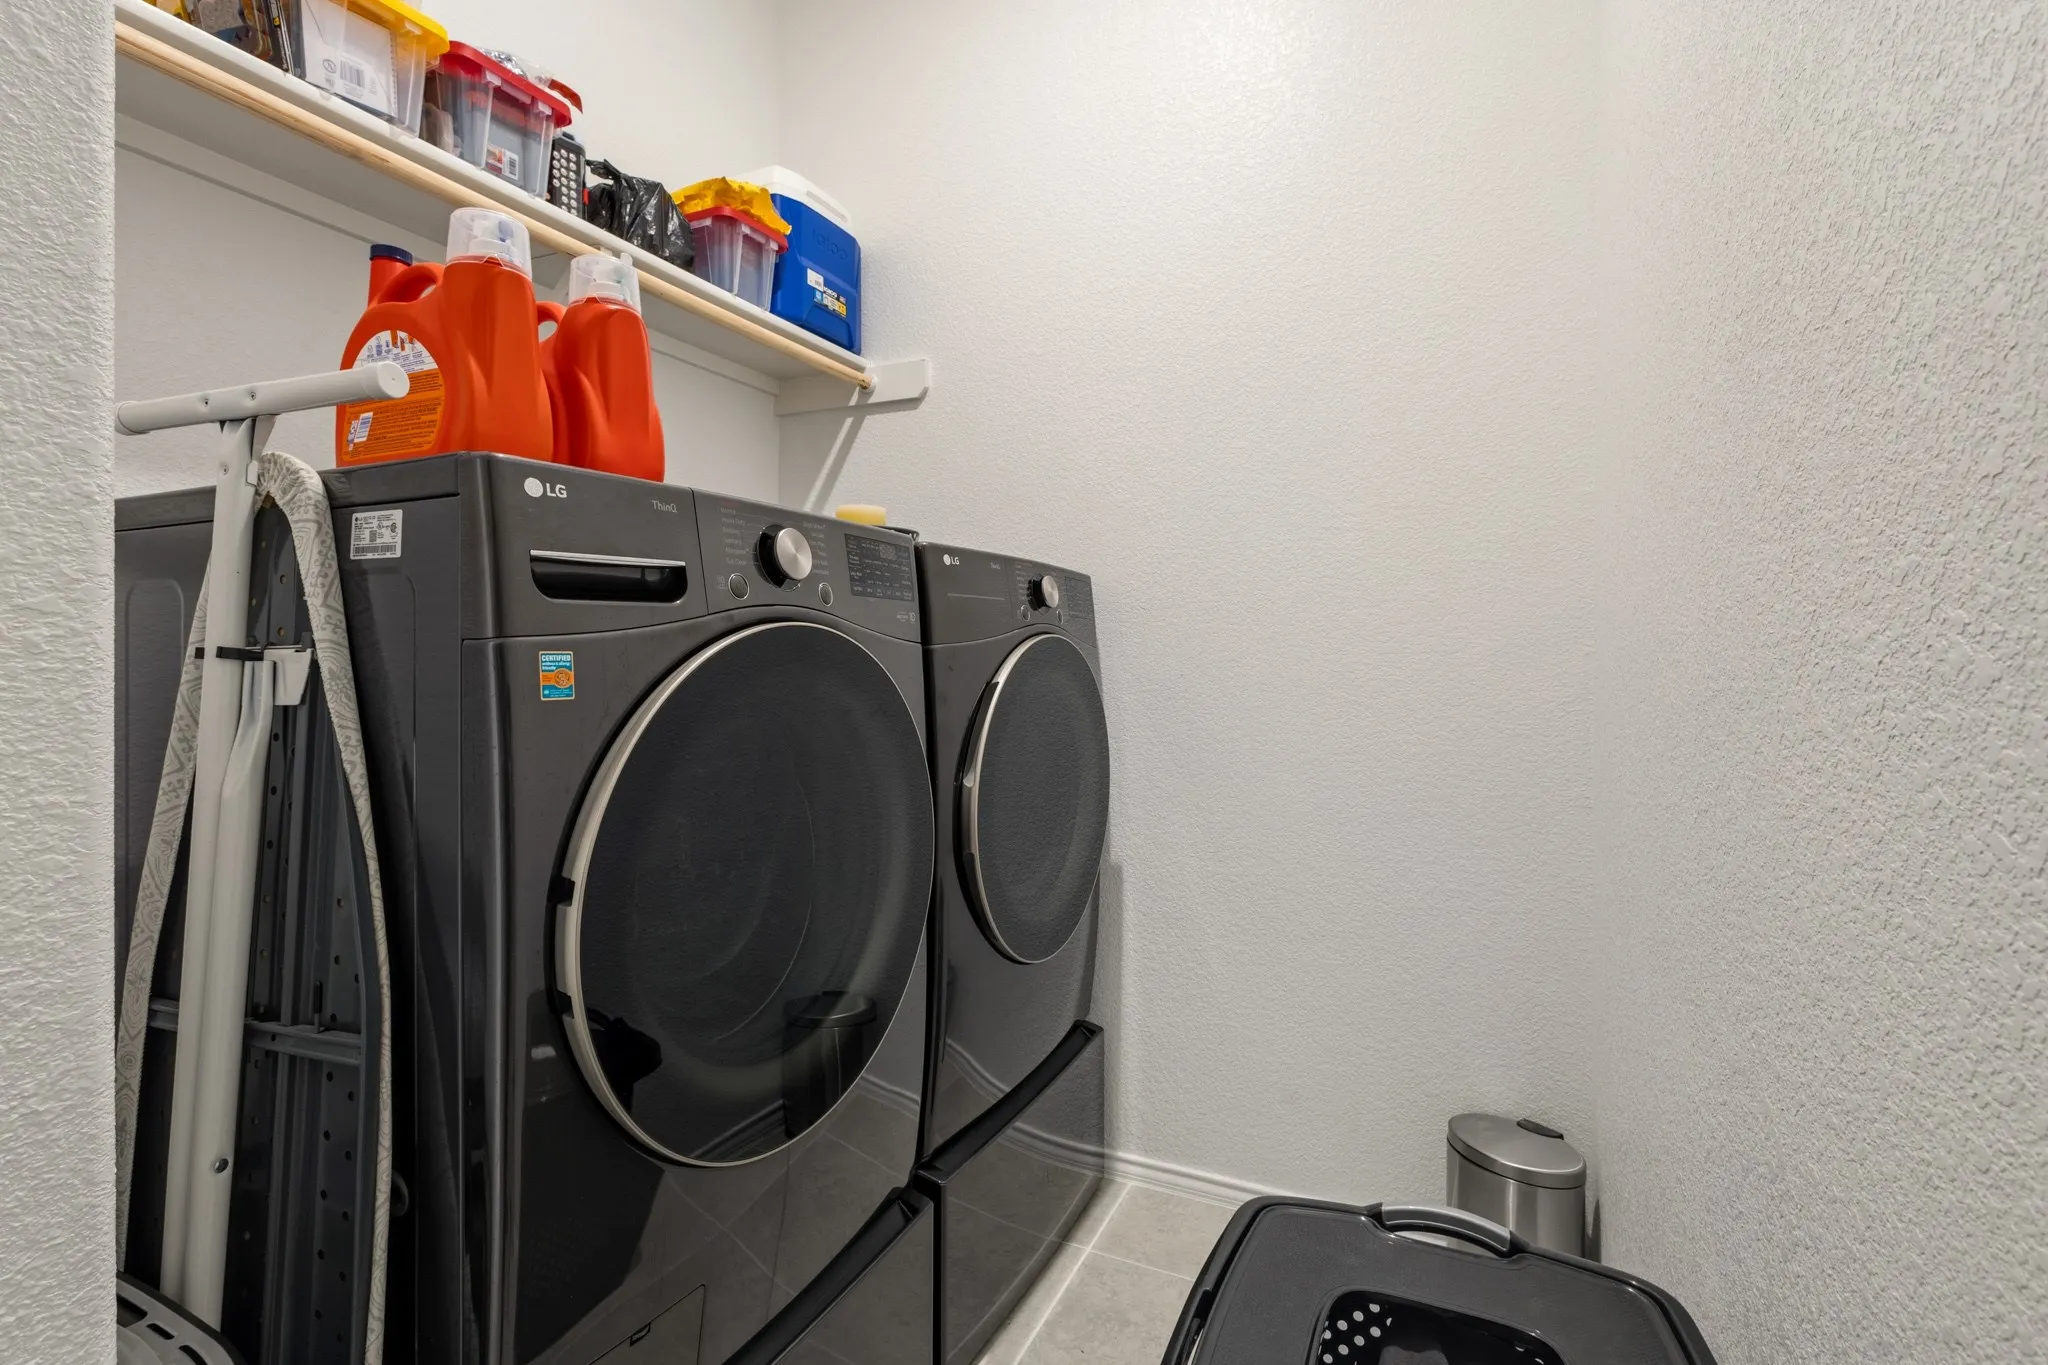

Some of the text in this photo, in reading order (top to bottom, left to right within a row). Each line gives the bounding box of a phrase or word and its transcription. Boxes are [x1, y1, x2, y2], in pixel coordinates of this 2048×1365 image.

[546, 482, 567, 498] LG
[652, 500, 678, 513] ThinQ
[951, 556, 960, 565] LG
